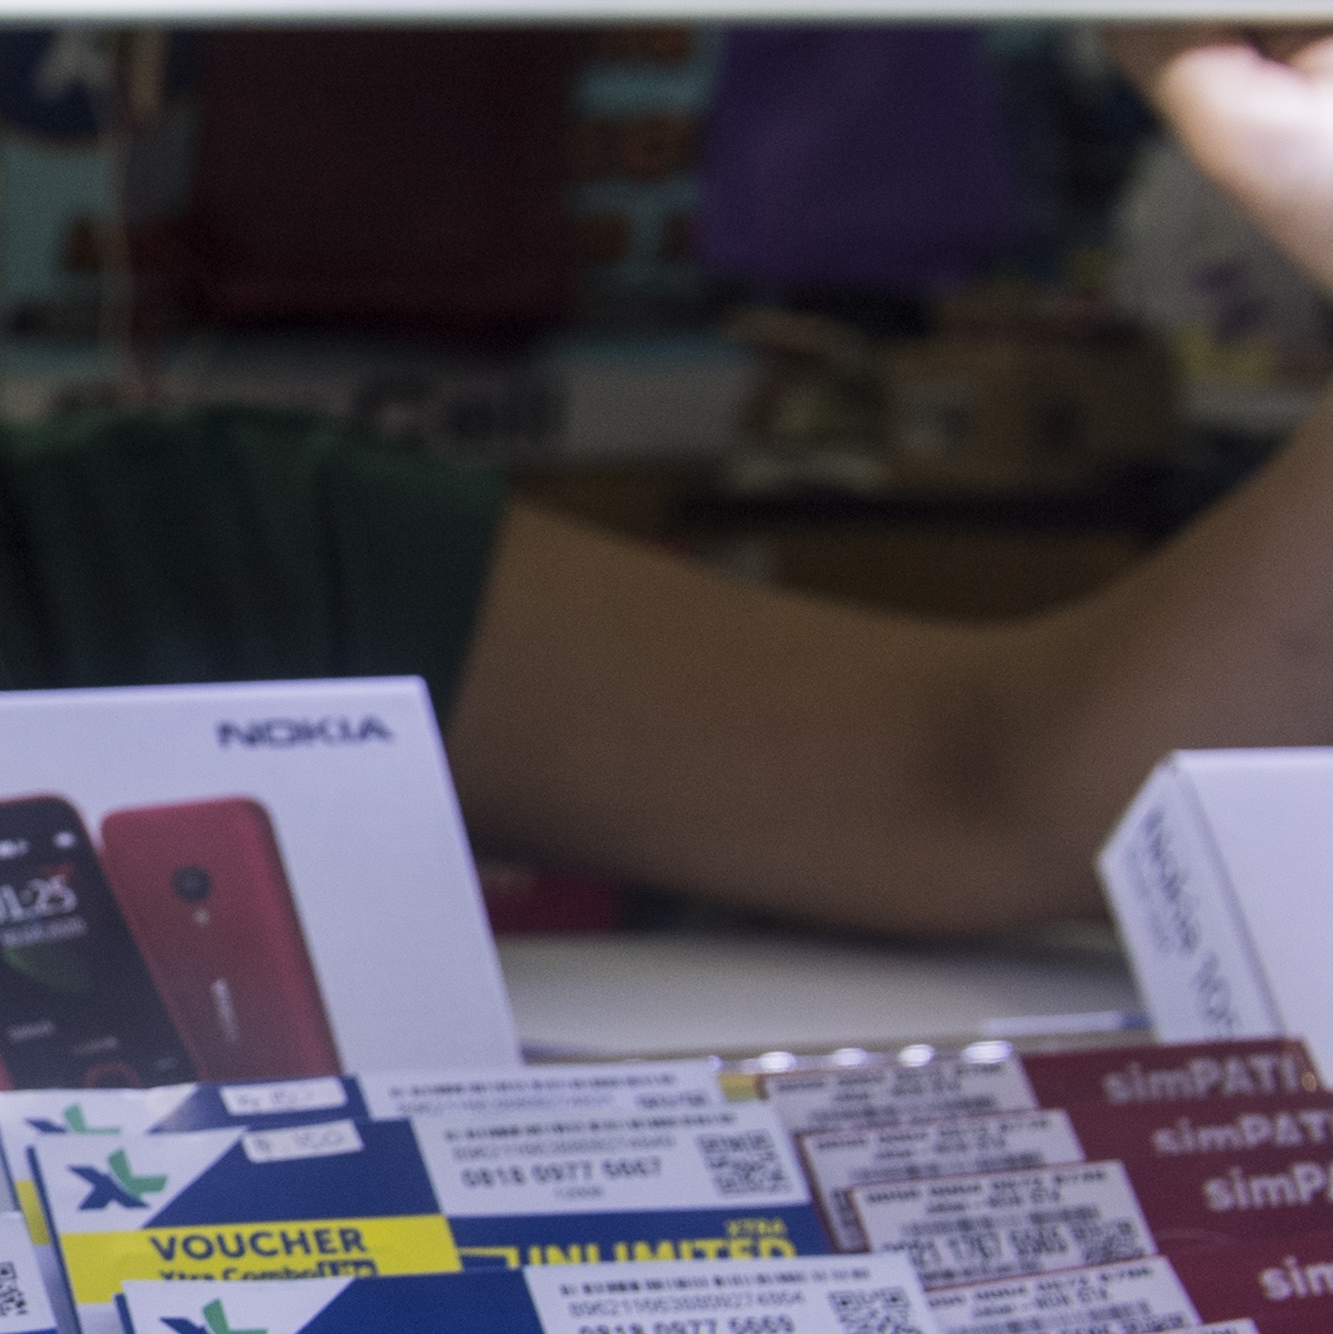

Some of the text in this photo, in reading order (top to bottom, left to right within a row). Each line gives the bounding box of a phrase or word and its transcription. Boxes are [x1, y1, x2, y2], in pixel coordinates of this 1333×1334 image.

[214, 716, 395, 750] NOKIA
[1101, 1053, 1299, 1105] simPATI
[1203, 1160, 1333, 1212] simP
[149, 1227, 368, 1262] VOUCHER
